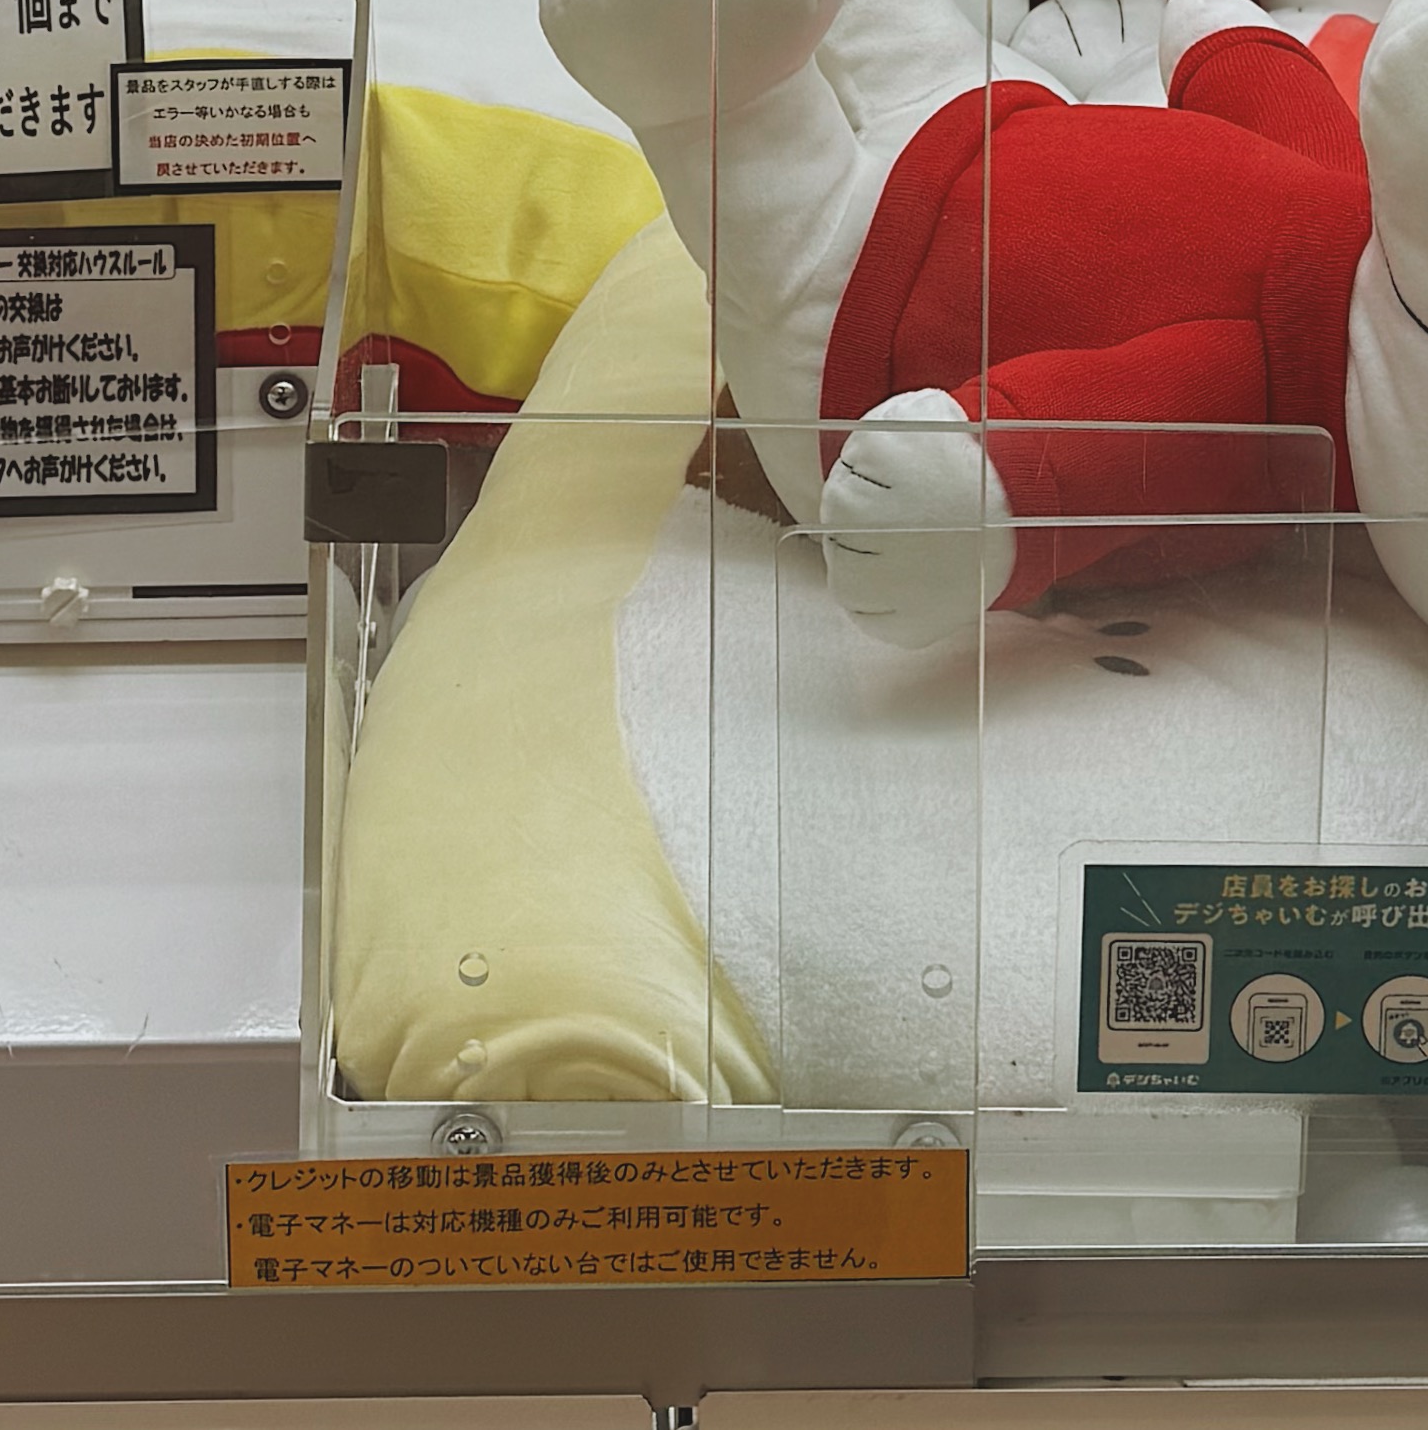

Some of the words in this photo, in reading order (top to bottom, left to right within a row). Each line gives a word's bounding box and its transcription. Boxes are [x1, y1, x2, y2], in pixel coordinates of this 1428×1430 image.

[126, 75, 337, 95] 景品をスタッフが手直しする際は
[153, 104, 311, 121] エラー等いかなる場合も
[148, 132, 317, 150] 当店の決めた初期位置へ
[157, 160, 306, 177] 戻させていただきます。
[254, 1247, 880, 1282] 電子マネーのついていない台ではご使用できません。
